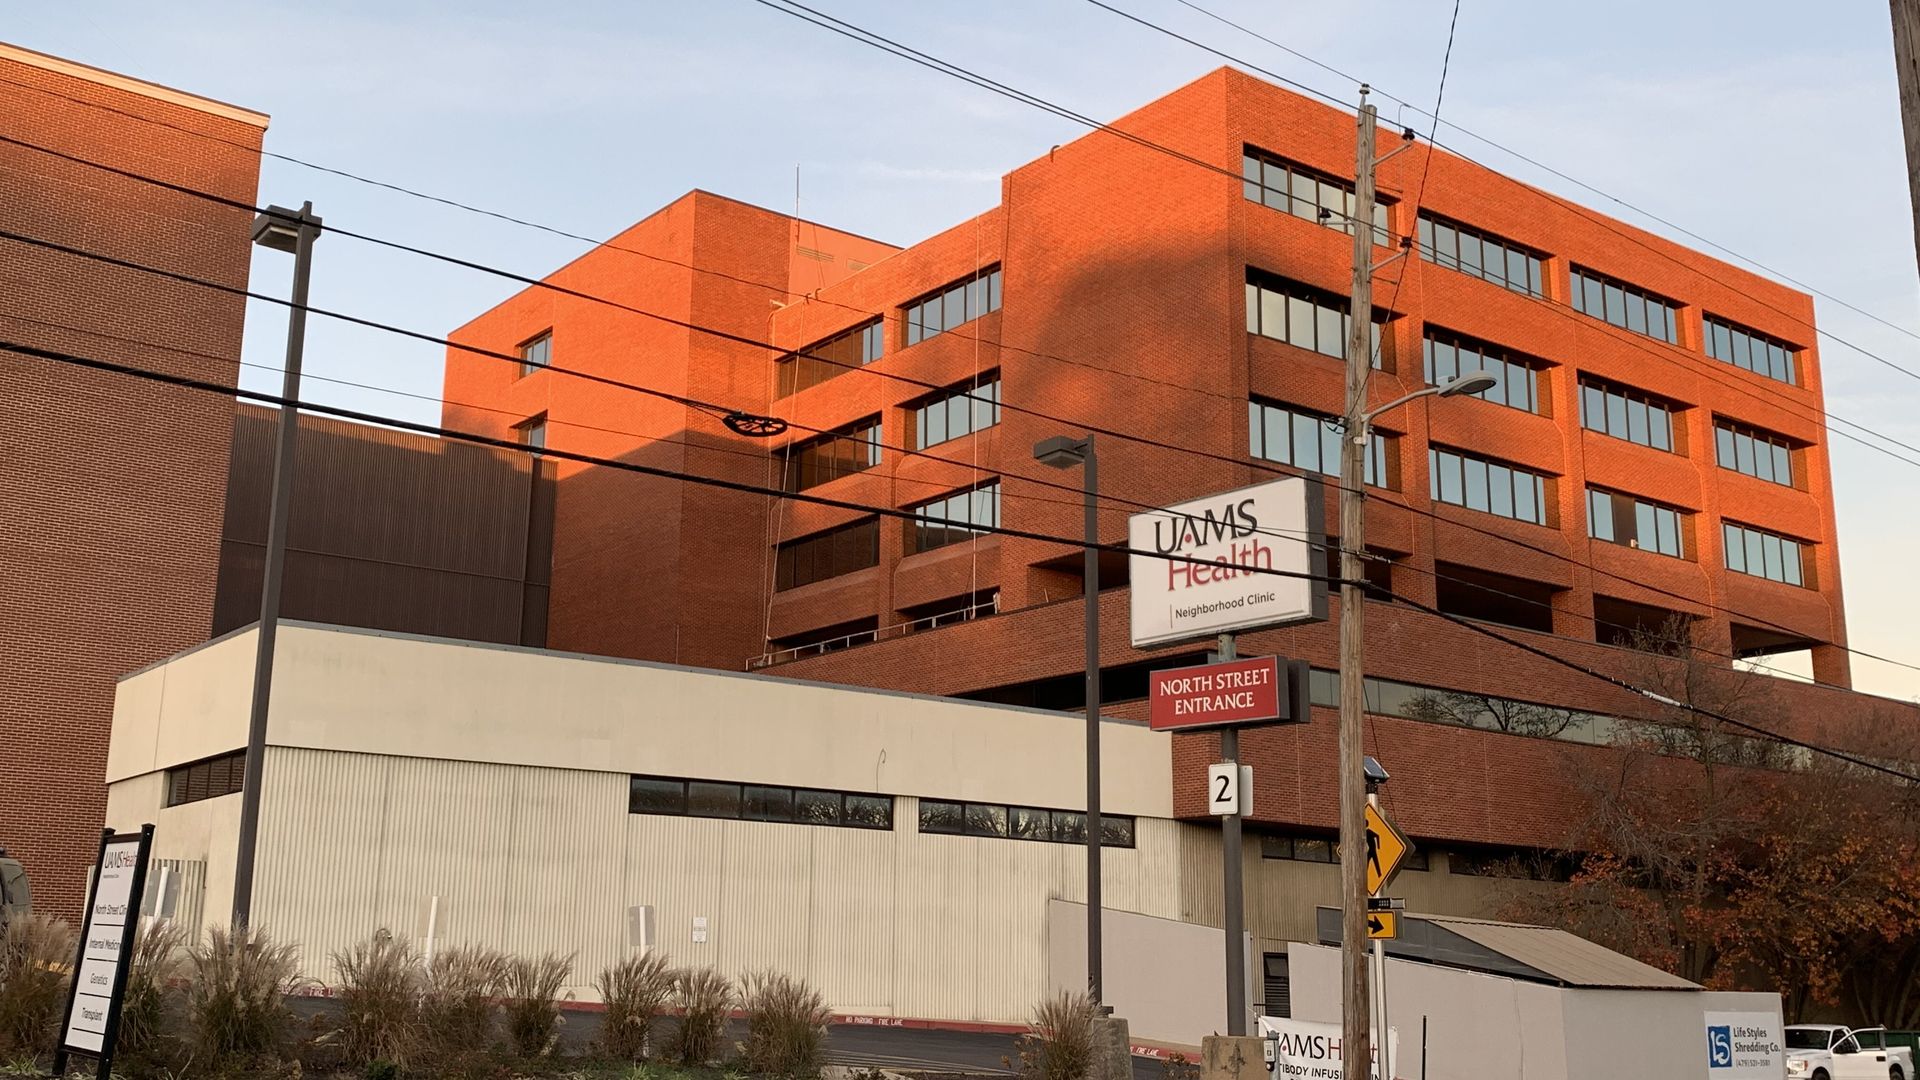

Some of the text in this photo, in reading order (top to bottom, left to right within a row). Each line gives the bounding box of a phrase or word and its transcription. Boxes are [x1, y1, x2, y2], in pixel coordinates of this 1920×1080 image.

[1154, 498, 1257, 554] UAMS
[1167, 539, 1272, 592] Health
[1175, 591, 1275, 619] Neighborhood Clinic
[1160, 668, 1270, 696] NORTH STREET
[1175, 692, 1254, 715] ENTRANCE
[1215, 775, 1232, 803] 2
[104, 851, 137, 869] UAMS Healt
[96, 904, 106, 915] North
[106, 904, 119, 915] Street
[89, 939, 121, 950] Internal Medicin
[90, 973, 108, 986] Genetics
[82, 1007, 103, 1022] Transplant
[1733, 1026, 1767, 1040] Life Styles
[1279, 1033, 1325, 1059] AMS
[1734, 1042, 1781, 1055] Shredding Co.
[1311, 1067, 1343, 1080] INFUSI
